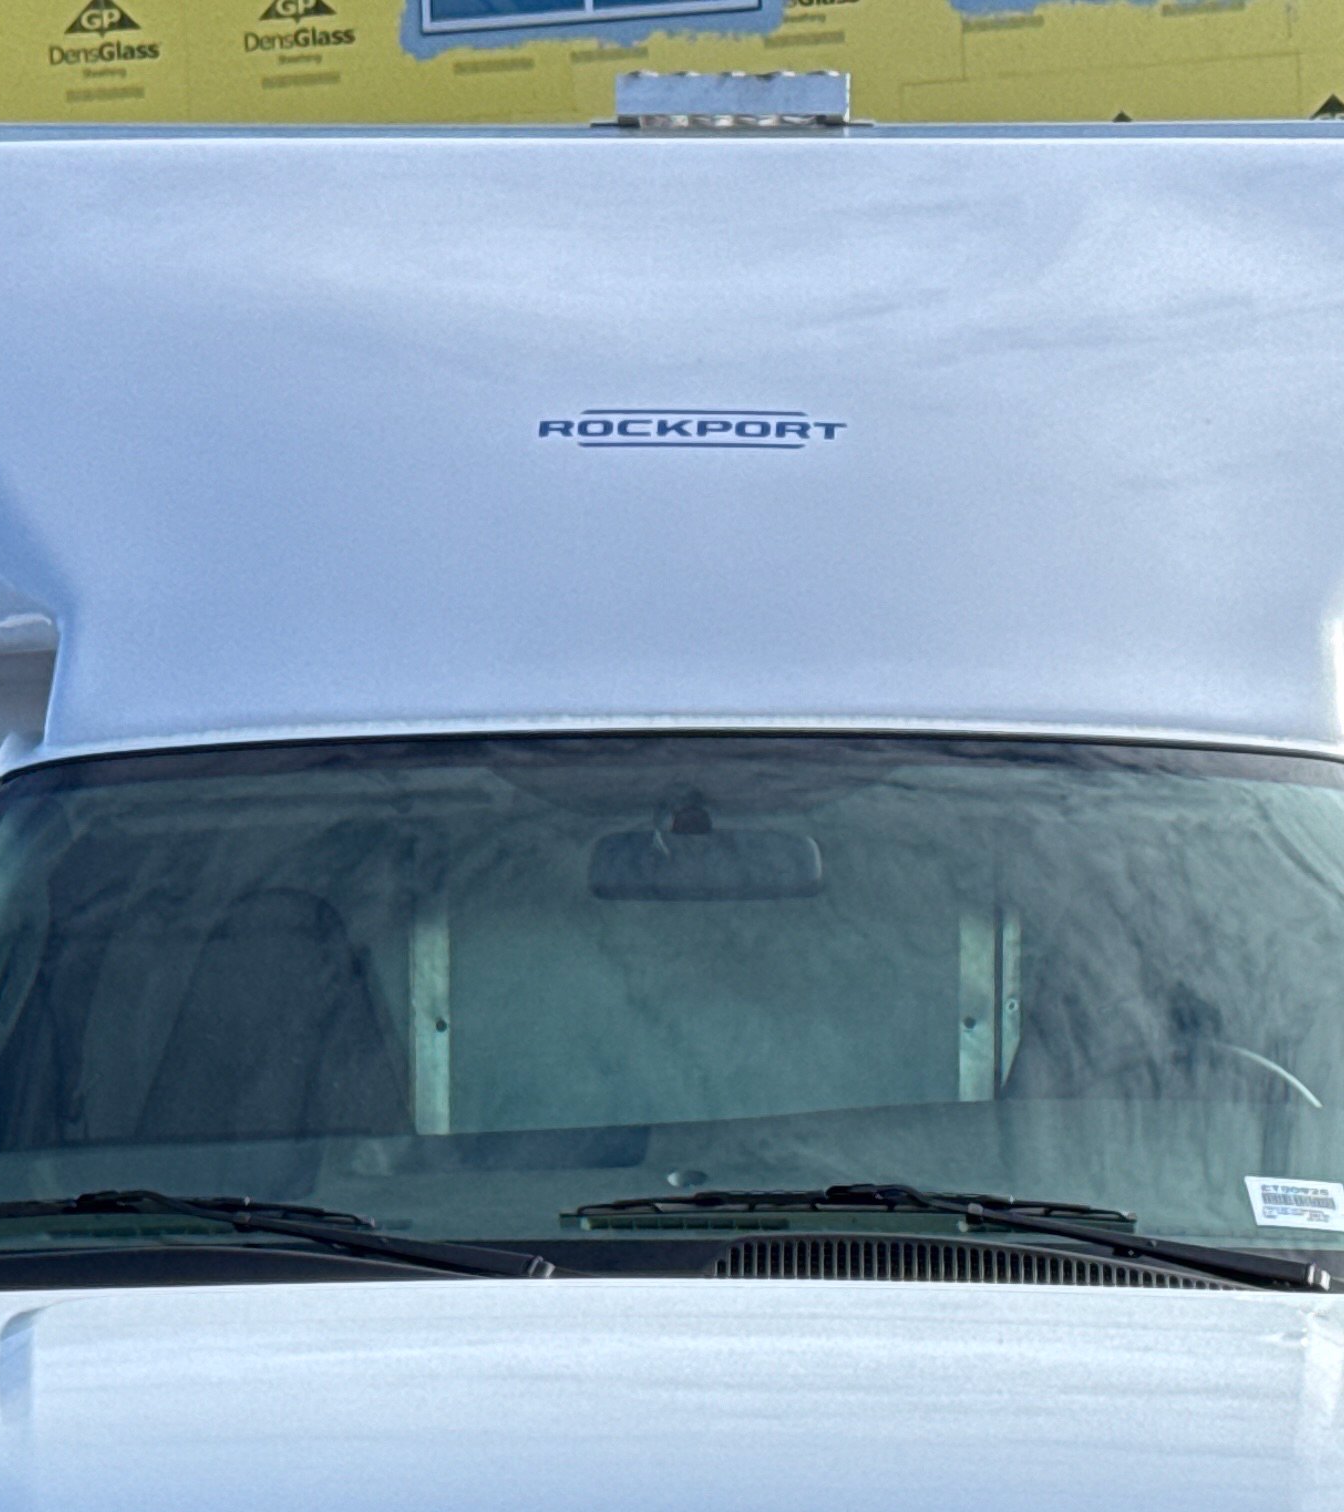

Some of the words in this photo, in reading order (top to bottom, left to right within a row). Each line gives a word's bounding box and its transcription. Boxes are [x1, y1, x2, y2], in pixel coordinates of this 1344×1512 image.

[81, 9, 122, 30] GP
[243, 26, 356, 52] DensGlass
[48, 40, 160, 66] DensGlass
[538, 418, 848, 441] ROCKPORT
